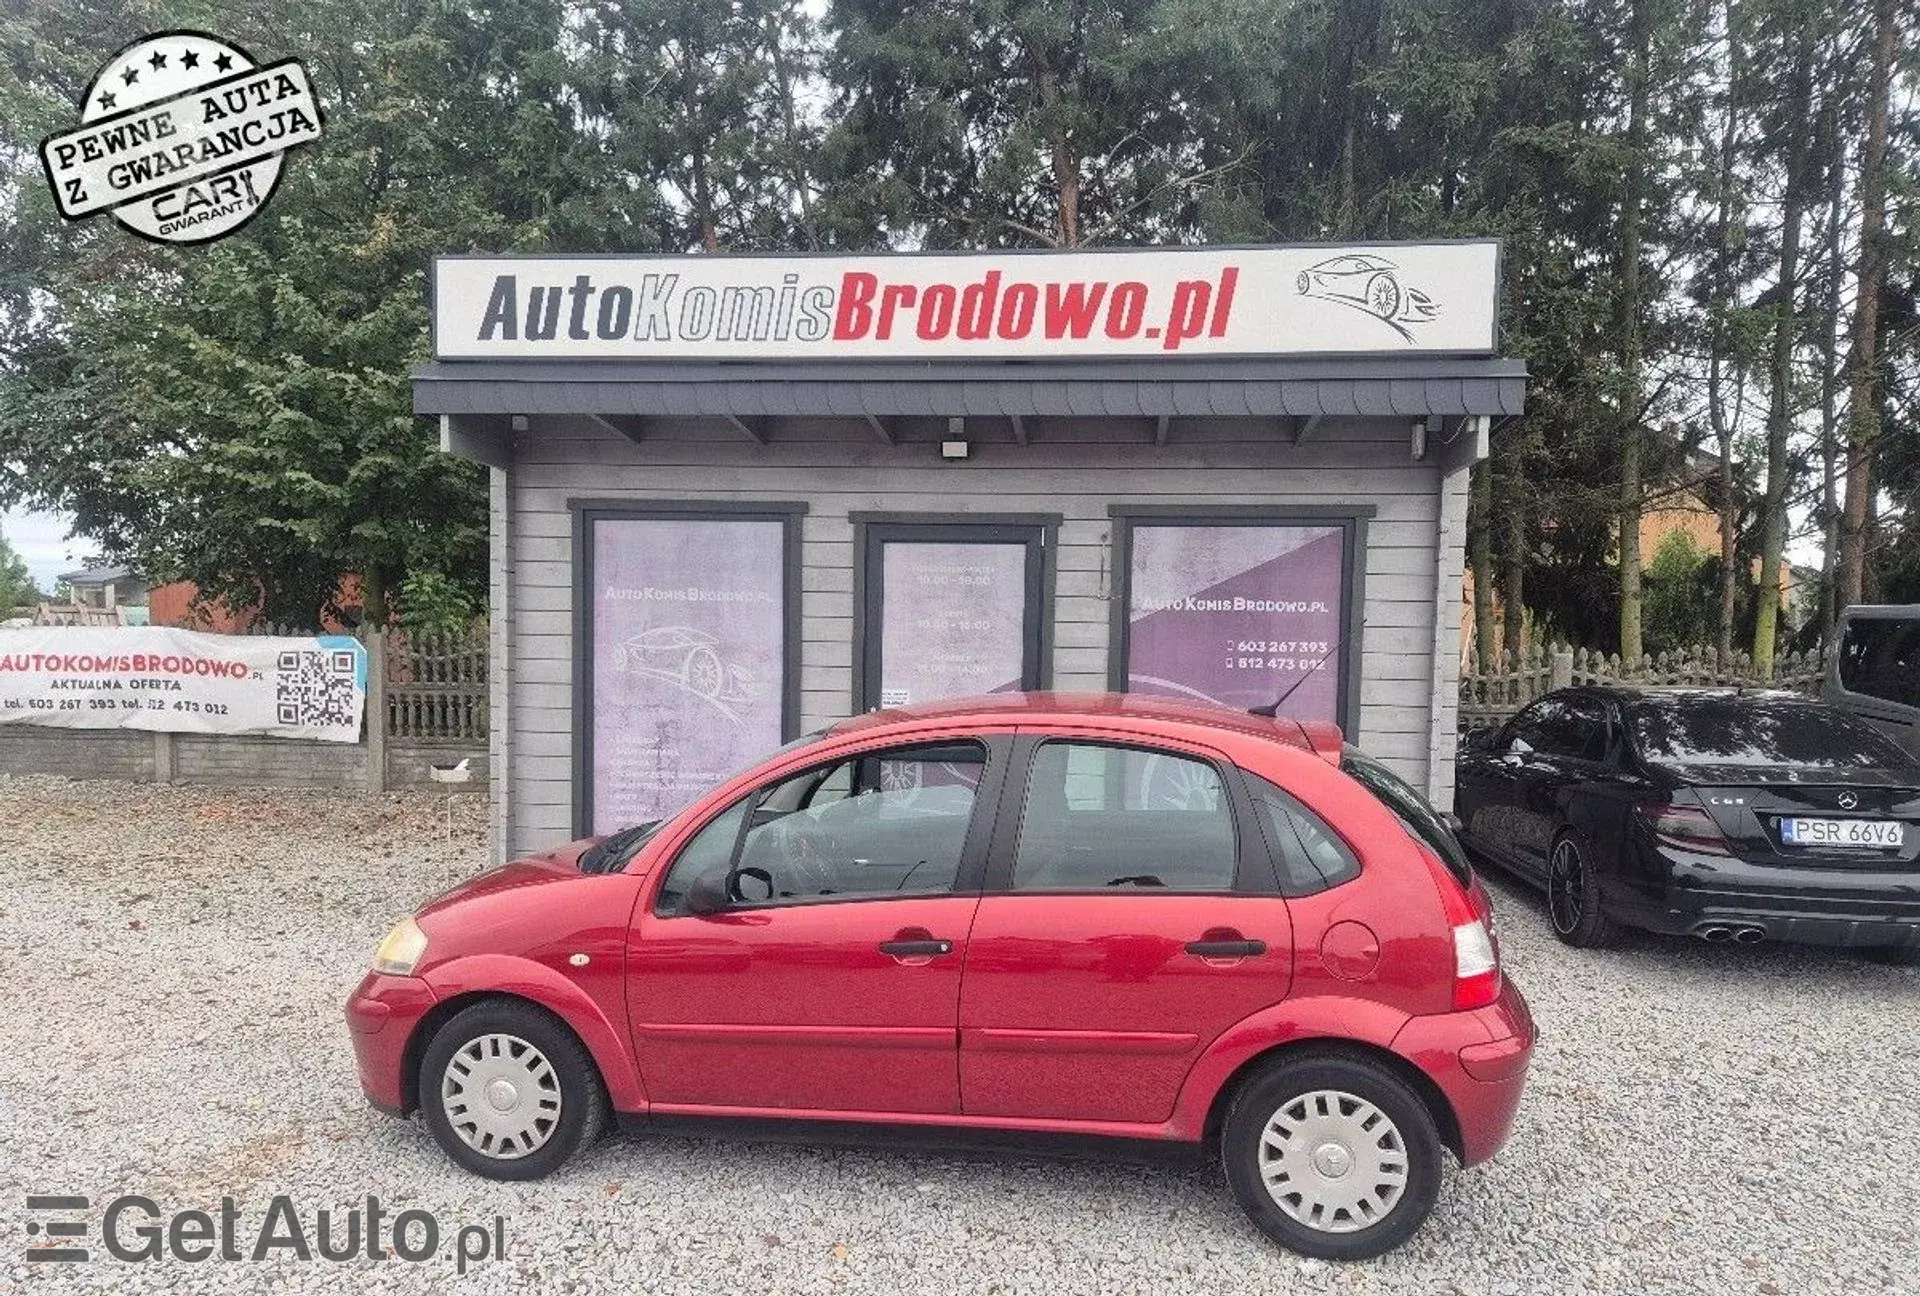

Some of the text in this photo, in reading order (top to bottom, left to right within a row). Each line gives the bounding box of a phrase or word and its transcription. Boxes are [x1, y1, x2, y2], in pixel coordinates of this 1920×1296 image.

[477, 267, 1240, 350] AutoKomisBrodowo.pl
[1237, 641, 1329, 653] 603 267 393
[1267, 657, 1296, 670] 473
[51, 679, 182, 691] AKTUALNA OFERTA
[4, 699, 24, 709] tel.
[59, 699, 82, 710] 267
[121, 699, 143, 709] tel.
[173, 700, 200, 712] 473
[204, 703, 229, 715] 012
[1796, 821, 1840, 841] PSR
[1849, 823, 1898, 843] 66V6
